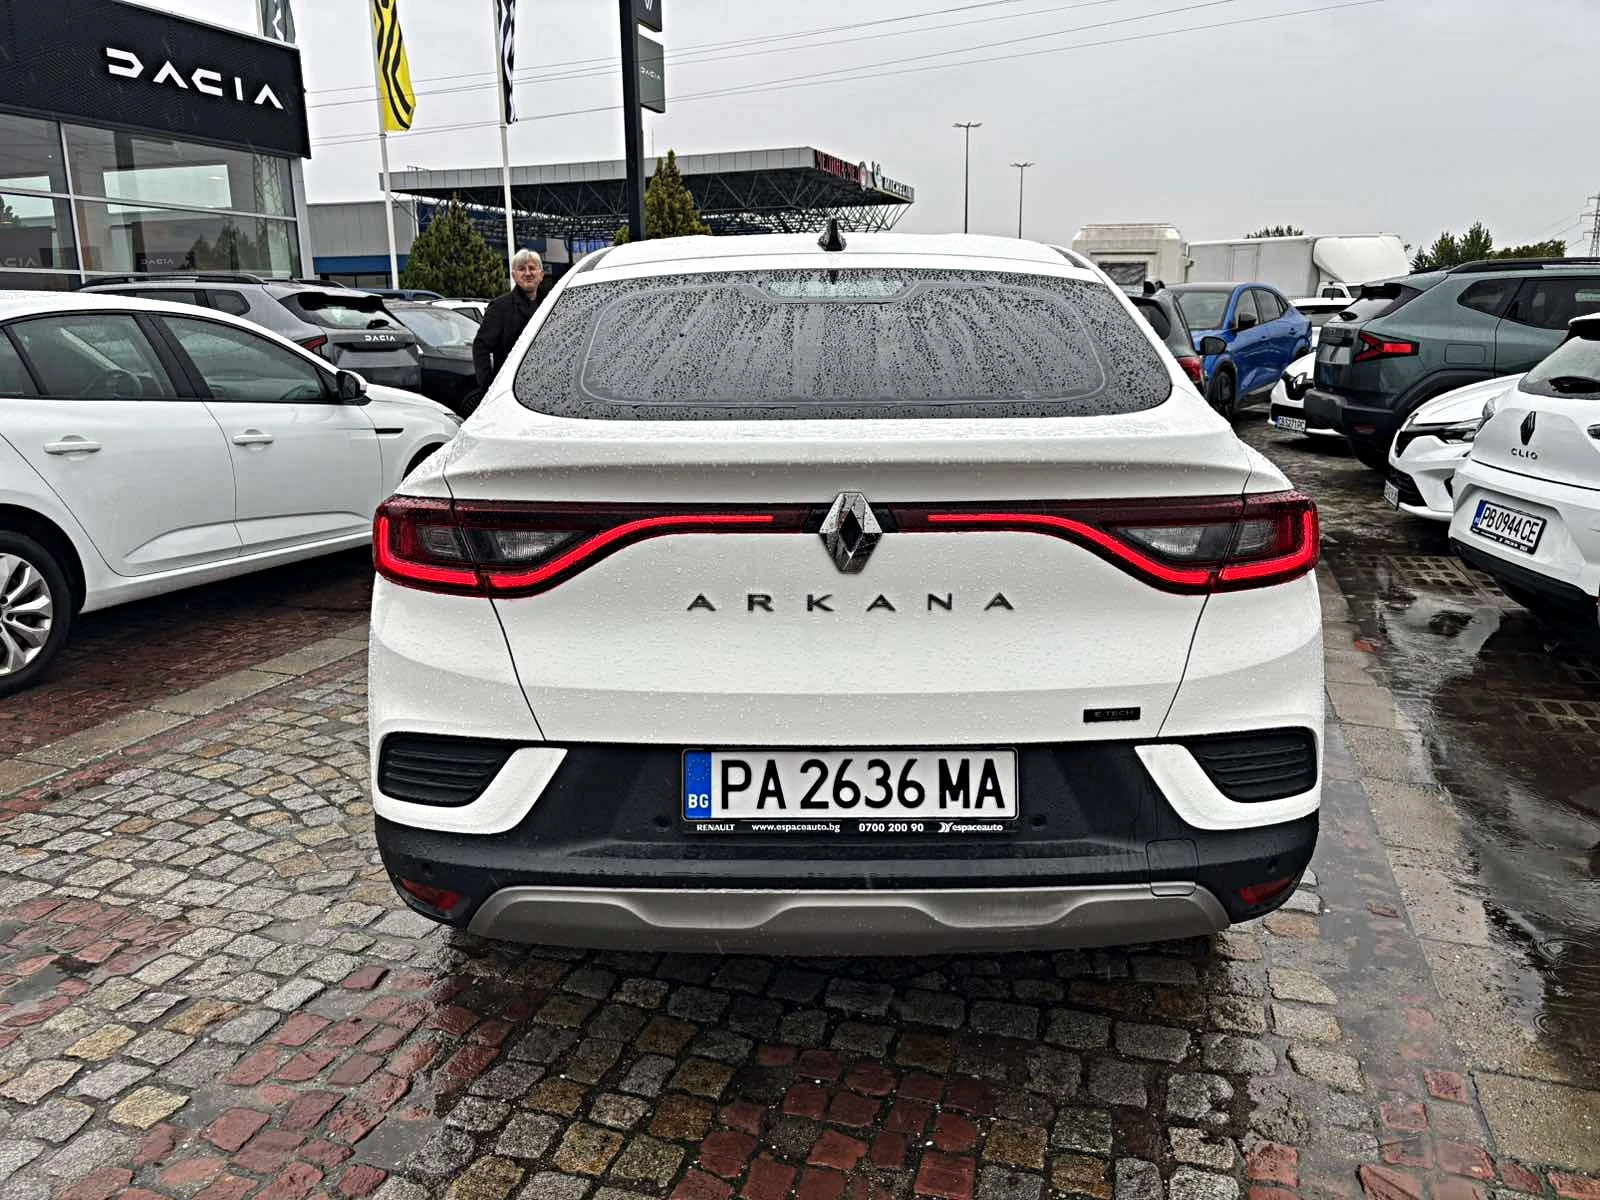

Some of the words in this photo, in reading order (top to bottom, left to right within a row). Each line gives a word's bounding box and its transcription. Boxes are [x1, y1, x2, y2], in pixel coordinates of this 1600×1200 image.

[106, 47, 284, 110] DACIA
[364, 334, 396, 343] DACIA
[1511, 447, 1539, 460] CLIO
[1479, 506, 1497, 528] PB
[1495, 511, 1523, 538] 0944
[1521, 519, 1540, 544] CE
[687, 592, 1015, 612] ARKANA
[721, 759, 787, 810] PA
[800, 758, 926, 810] 2636
[938, 758, 1006, 809] MA
[688, 793, 709, 809] BG
[696, 823, 735, 832] RENAULT
[751, 822, 841, 833] www.espaceauto.bg
[858, 823, 886, 832] 0700
[888, 823, 908, 832] 200
[911, 823, 925, 832] 90
[952, 823, 1004, 833] espaceauto
